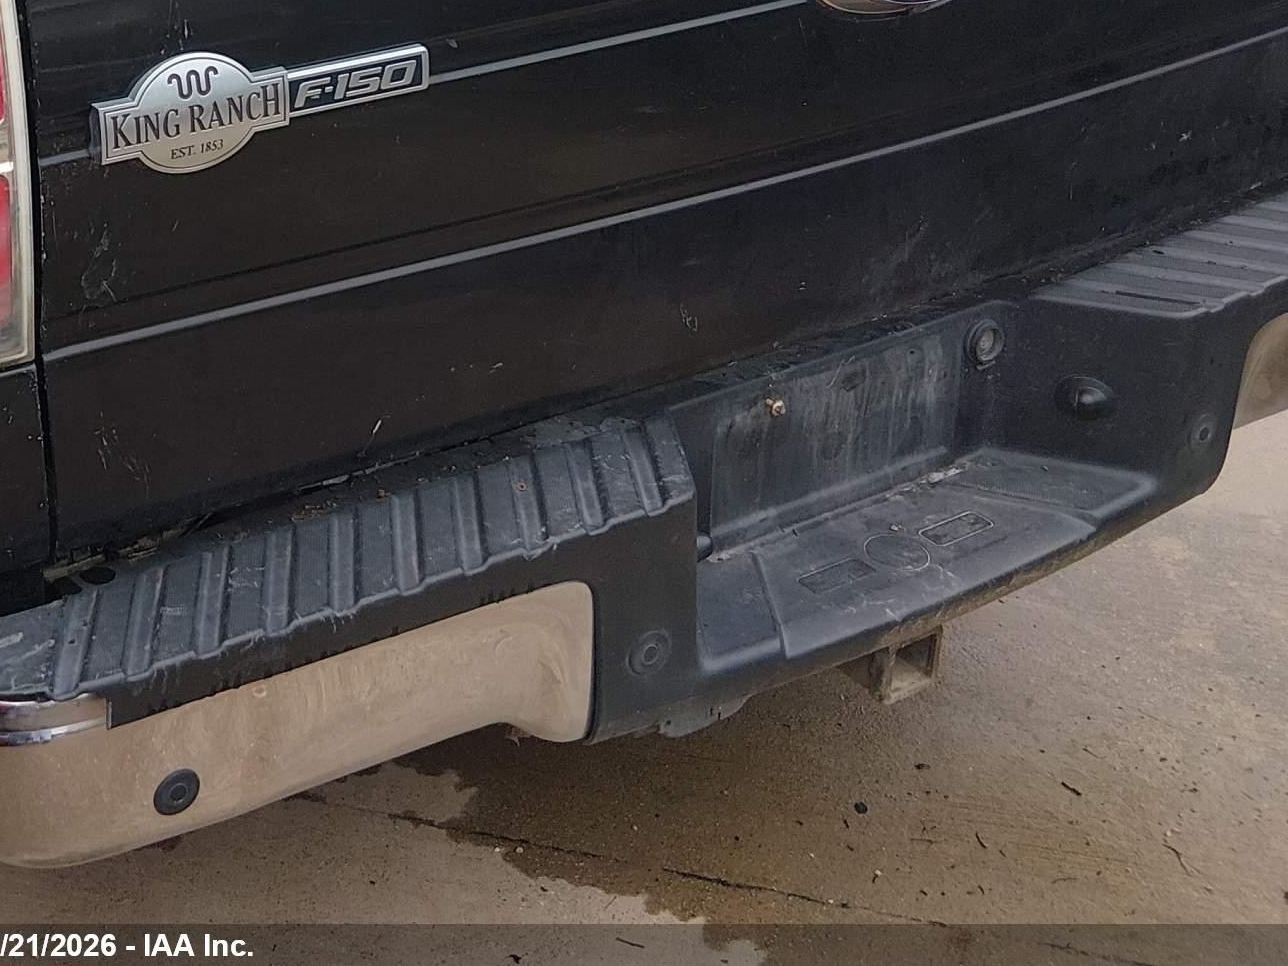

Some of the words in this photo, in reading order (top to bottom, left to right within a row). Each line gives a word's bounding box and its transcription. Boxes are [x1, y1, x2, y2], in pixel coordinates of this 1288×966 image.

[294, 59, 417, 109] F-150
[110, 107, 181, 150] KING
[188, 83, 281, 133] RANCH
[170, 141, 196, 160] EST.
[199, 138, 224, 155] 1853
